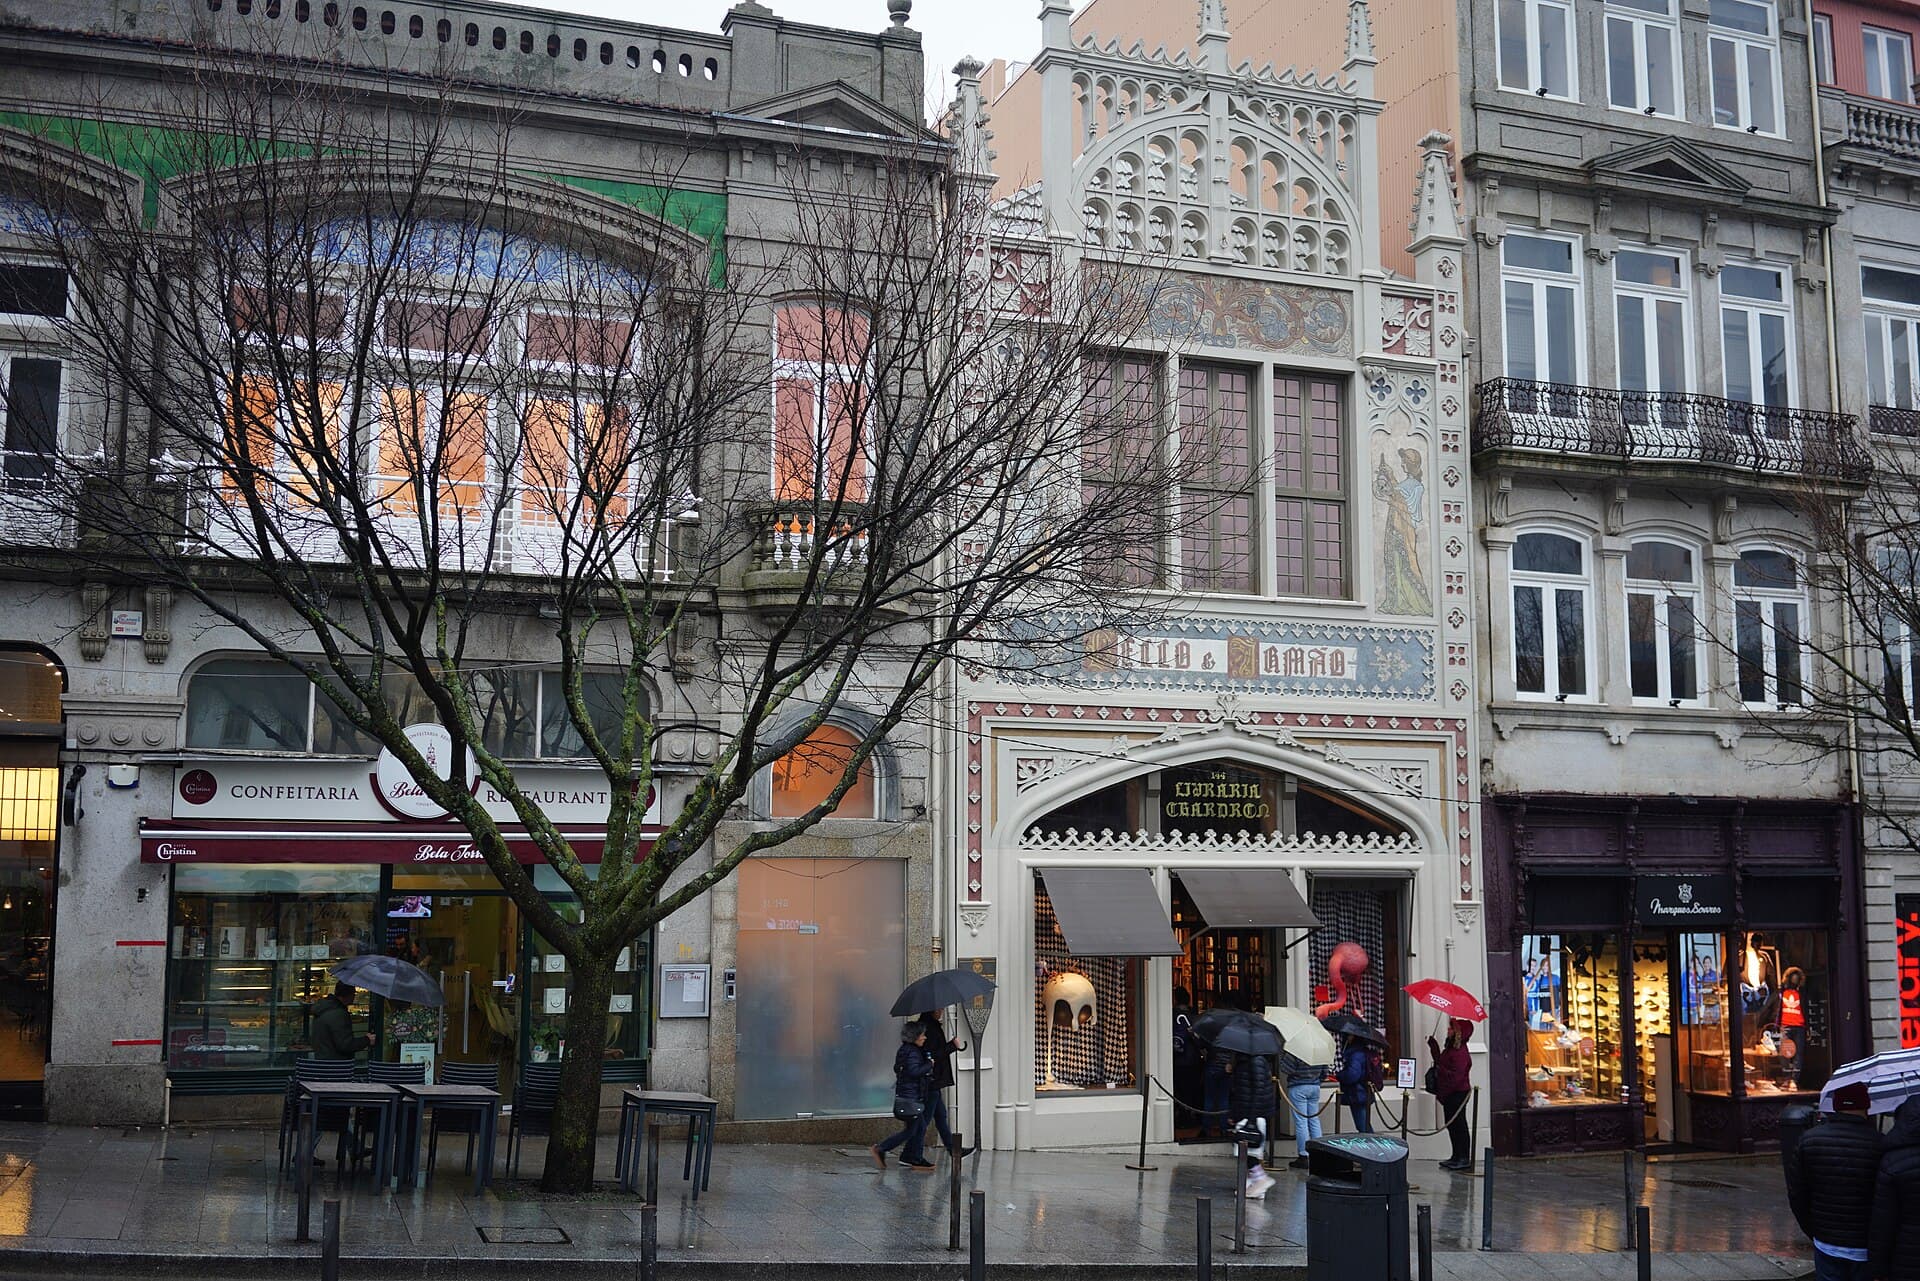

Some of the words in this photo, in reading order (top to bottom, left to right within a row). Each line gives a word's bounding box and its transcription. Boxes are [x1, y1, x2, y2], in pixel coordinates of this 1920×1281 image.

[1201, 651, 1216, 671] &
[1227, 635, 1346, 680] IRMÃO
[231, 785, 360, 801] CONFEITARIA
[389, 781, 425, 799] Bela
[1175, 782, 1262, 799] LIVRARIA
[1166, 801, 1271, 818] CHARDRON
[157, 843, 197, 860] Christina
[413, 844, 450, 861] Bela
[450, 843, 484, 862] Torr
[1650, 898, 1691, 917] Marques
[1690, 902, 1722, 914] Soares
